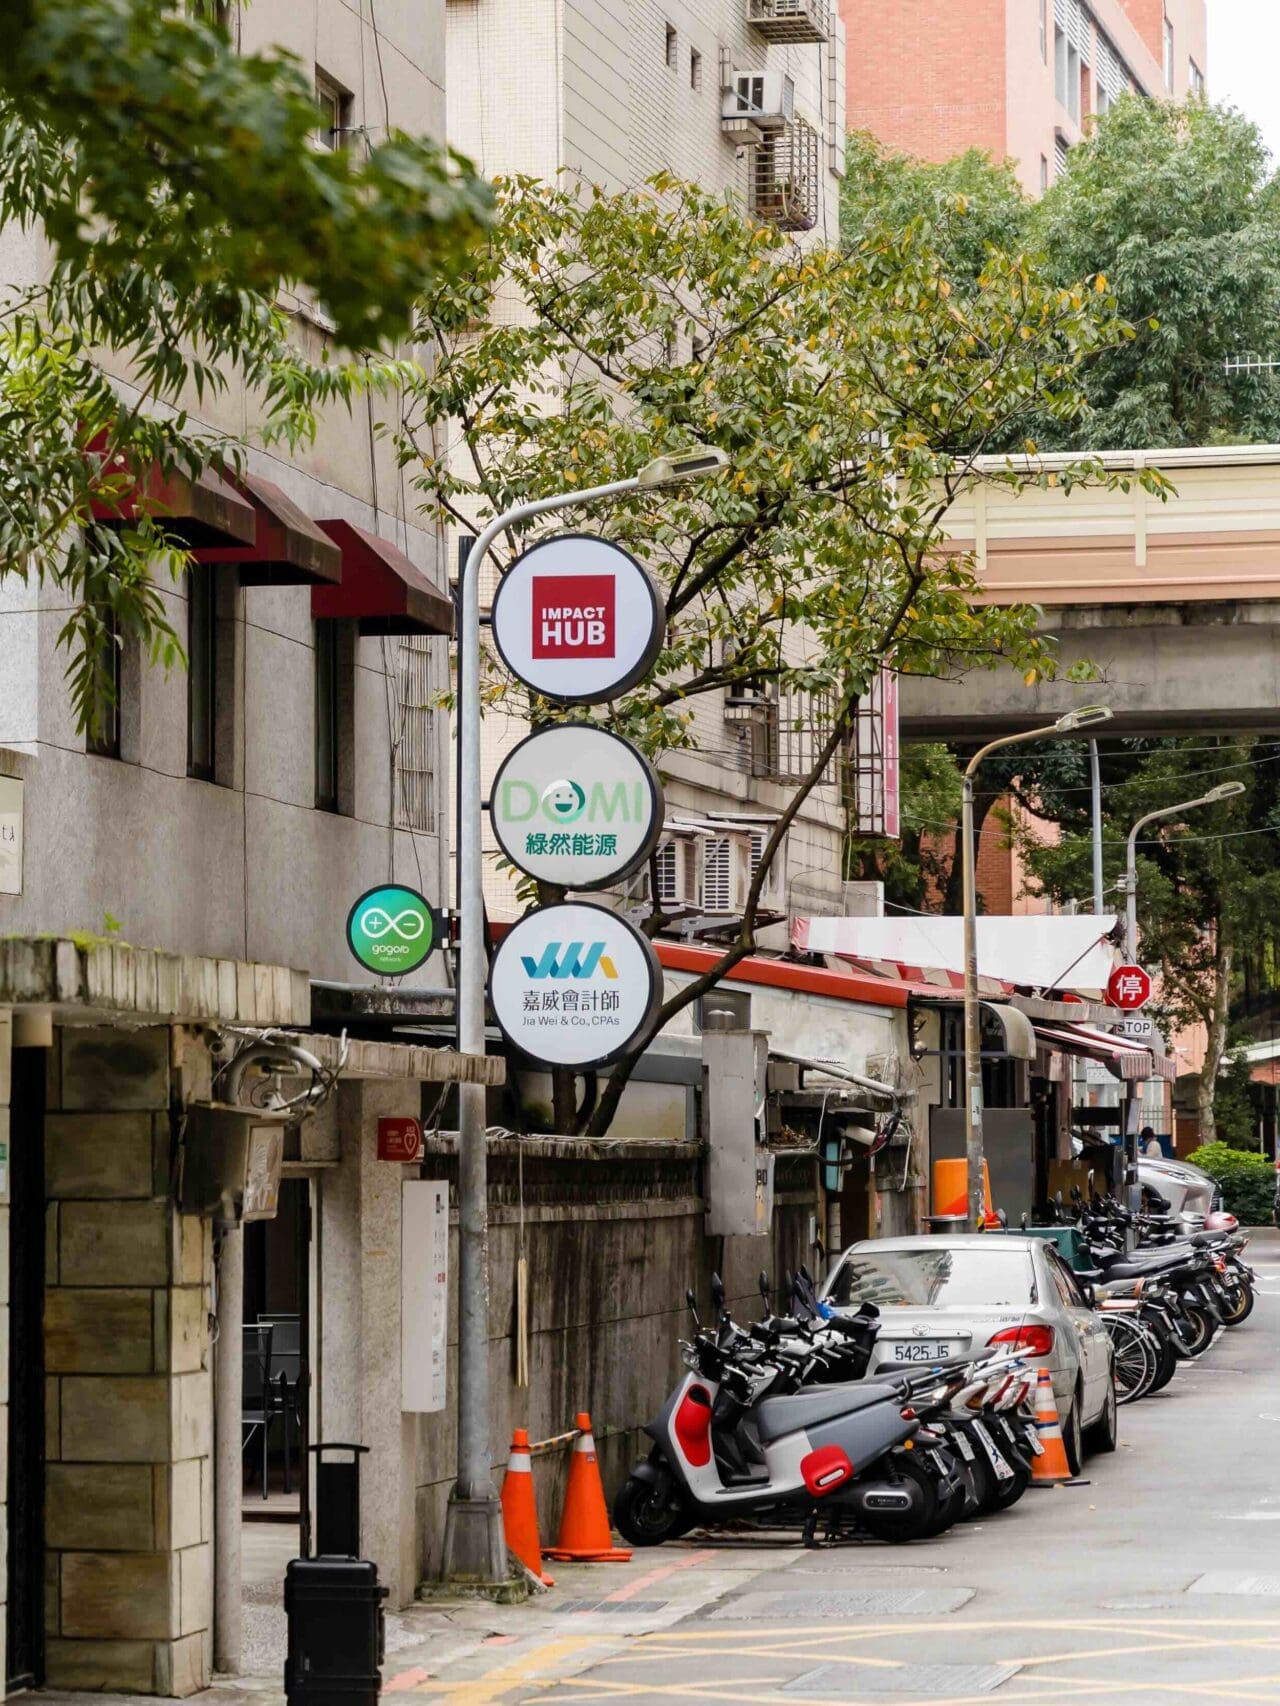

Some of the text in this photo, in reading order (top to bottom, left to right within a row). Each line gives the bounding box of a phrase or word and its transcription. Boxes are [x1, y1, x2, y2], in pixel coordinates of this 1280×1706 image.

[542, 606, 606, 620] IMPACT
[542, 620, 606, 646] HUB
[501, 779, 644, 825] DOMI
[525, 832, 618, 856] 綠然能源
[1115, 974, 1143, 1001] 停
[522, 989, 620, 1012] 嘉威會計師
[522, 1015, 536, 1026] Jia
[538, 1015, 558, 1026] Wei
[560, 1015, 569, 1026] &
[591, 1015, 620, 1026] CPAs
[1118, 1021, 1151, 1034] STOP
